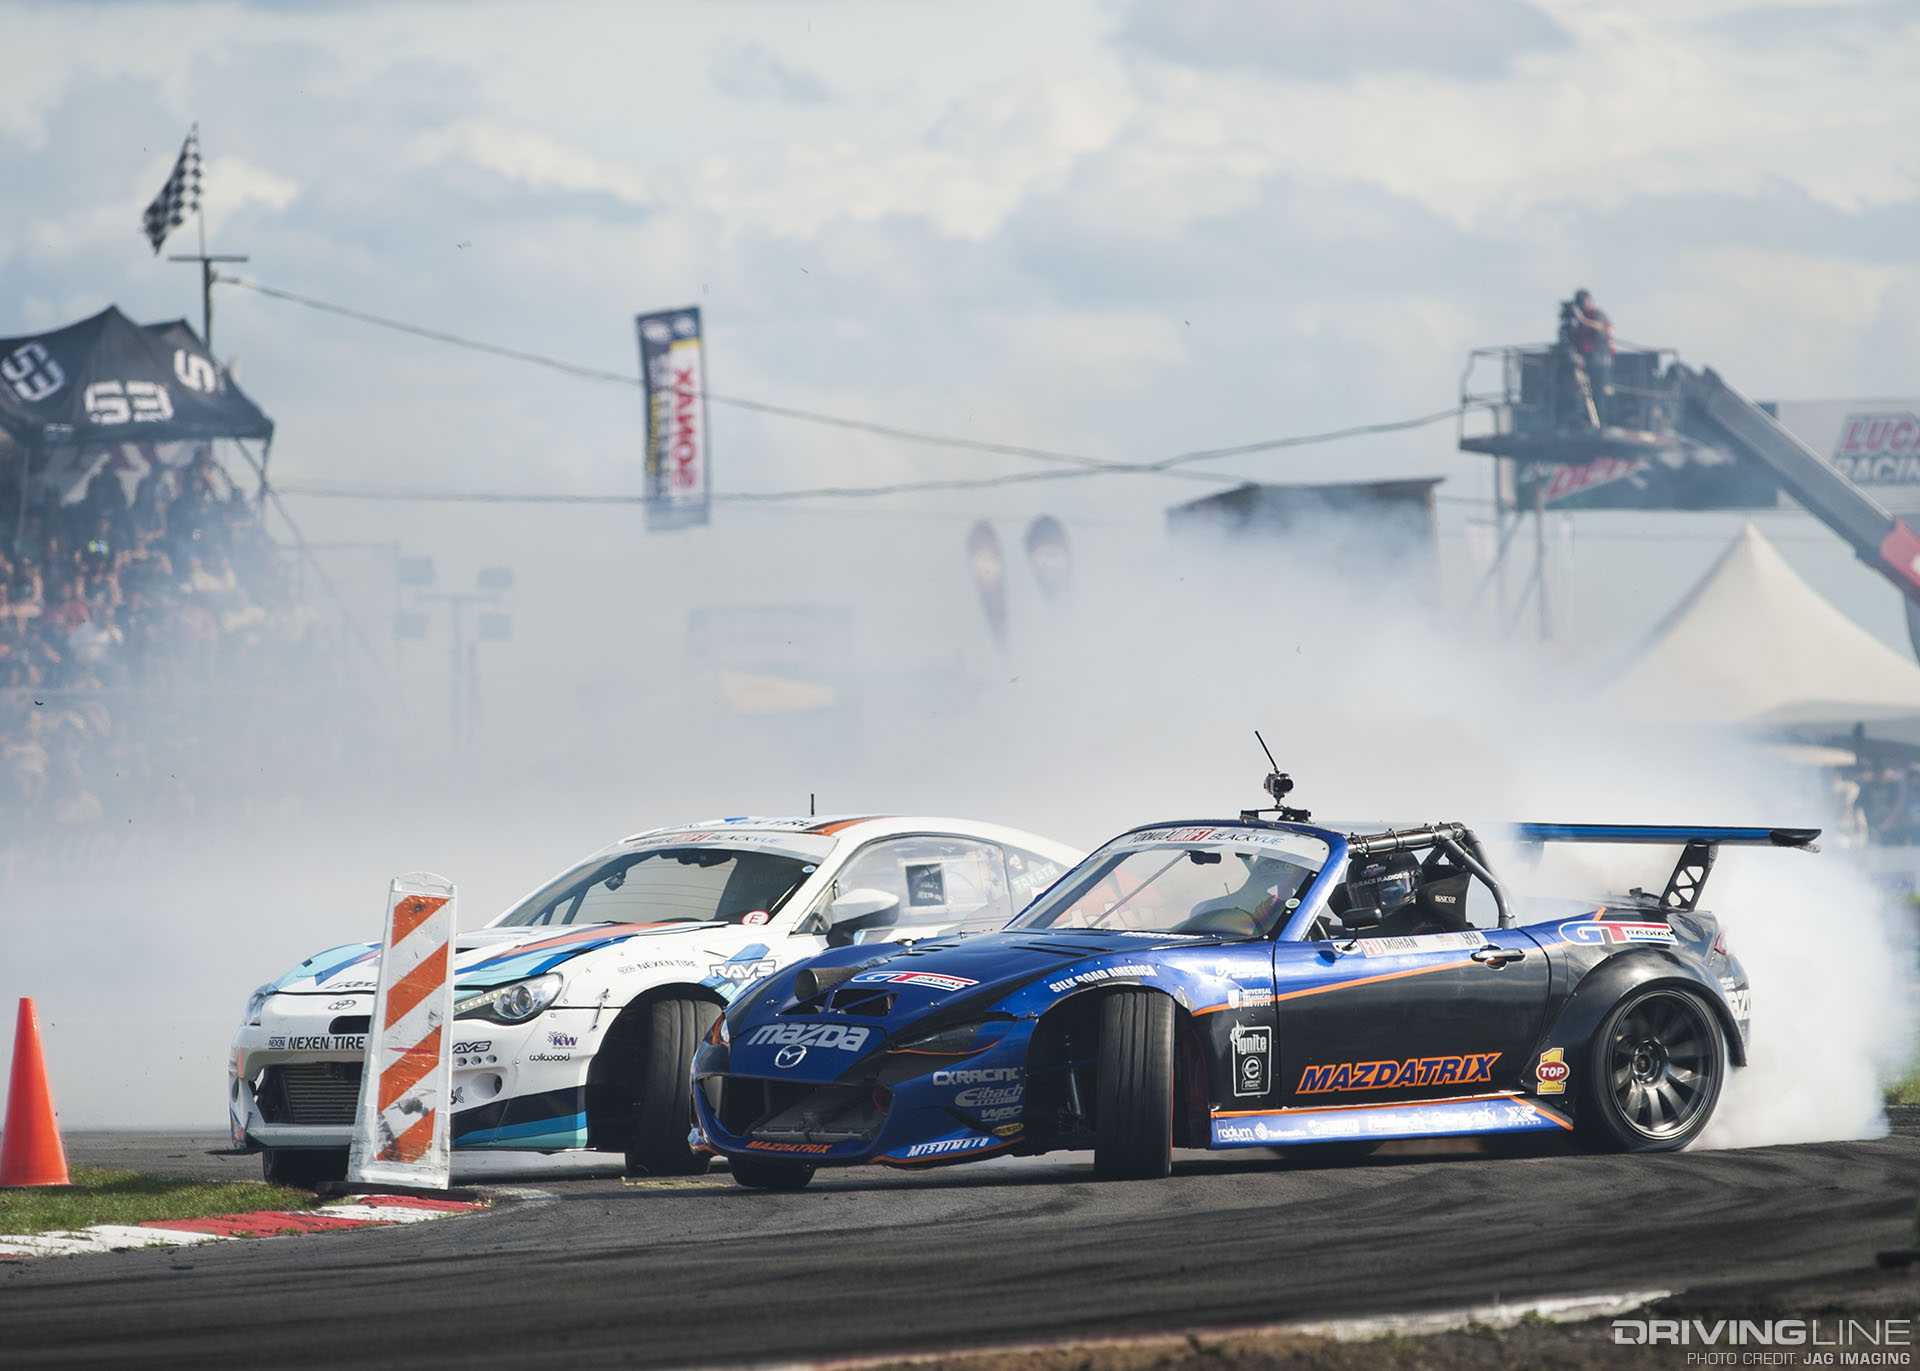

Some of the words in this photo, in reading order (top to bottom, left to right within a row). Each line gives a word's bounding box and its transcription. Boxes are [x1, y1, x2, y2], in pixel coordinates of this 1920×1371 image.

[672, 367, 697, 488] SONAX
[1208, 833, 1286, 846] BLACKVUE
[1381, 937, 1418, 950] MOHAN
[637, 959, 675, 971] NEXEN
[676, 960, 698, 969] TIRE
[709, 959, 777, 981] RAYS
[1050, 977, 1078, 993] SILK
[1107, 964, 1158, 977] AMERICA
[288, 1036, 330, 1050] NEXEN
[332, 1036, 365, 1050] TIRE
[453, 1041, 492, 1054] AYS
[552, 1035, 578, 1047] KW
[1236, 1033, 1267, 1055] ignite
[528, 1052, 571, 1062] wilwood
[1296, 1052, 1502, 1094] MAZDATRIX
[1540, 1066, 1565, 1078] TOP
[954, 1084, 1024, 1107] Eibach
[1217, 1123, 1254, 1139] radium
[745, 1140, 833, 1154] MAZDATRIX
[907, 1137, 990, 1157] MISHIMOTO
